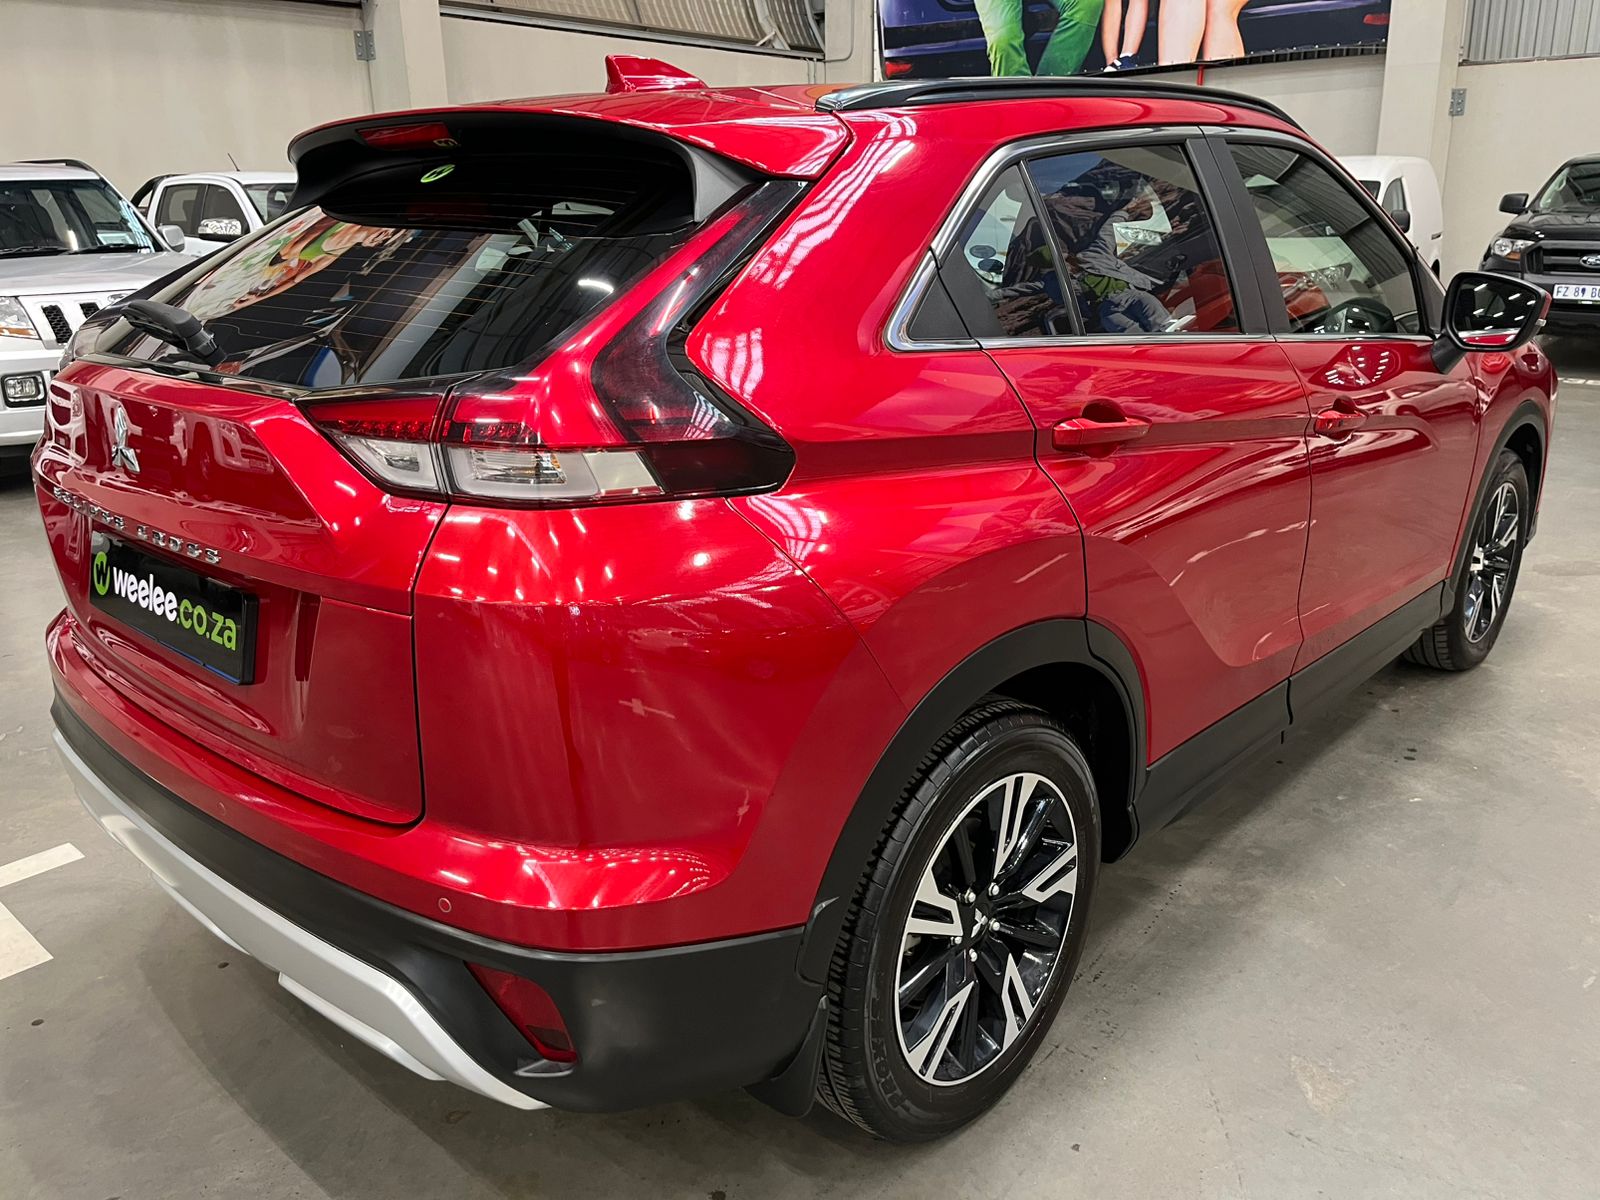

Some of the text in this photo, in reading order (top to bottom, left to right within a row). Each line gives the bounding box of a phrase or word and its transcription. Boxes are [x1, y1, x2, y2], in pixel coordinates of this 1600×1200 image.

[1556, 286, 1569, 297] FZ
[137, 524, 221, 564] CROSS
[113, 566, 237, 651] weelee.co.za
